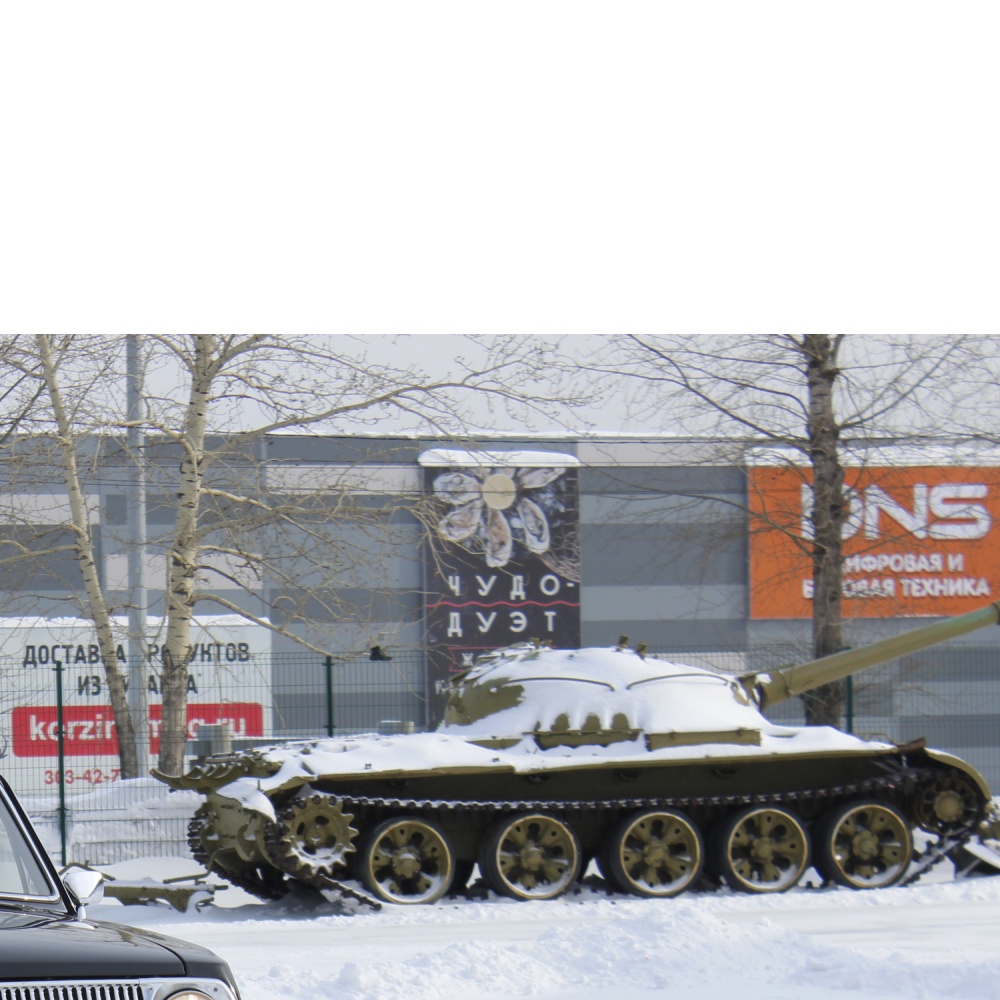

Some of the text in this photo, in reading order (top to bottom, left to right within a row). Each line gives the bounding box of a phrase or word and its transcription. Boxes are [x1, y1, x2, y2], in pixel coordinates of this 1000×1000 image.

[842, 552, 965, 573] ИФРОВАЯ И
[448, 575, 575, 600] ЧУДО-
[802, 578, 991, 598] БОВАЯ ТЕХНИКА
[447, 611, 556, 637] ДУЭТ
[23, 643, 250, 668] ДОСТАВА РОУКТОВ
[78, 675, 101, 696] ИЗ
